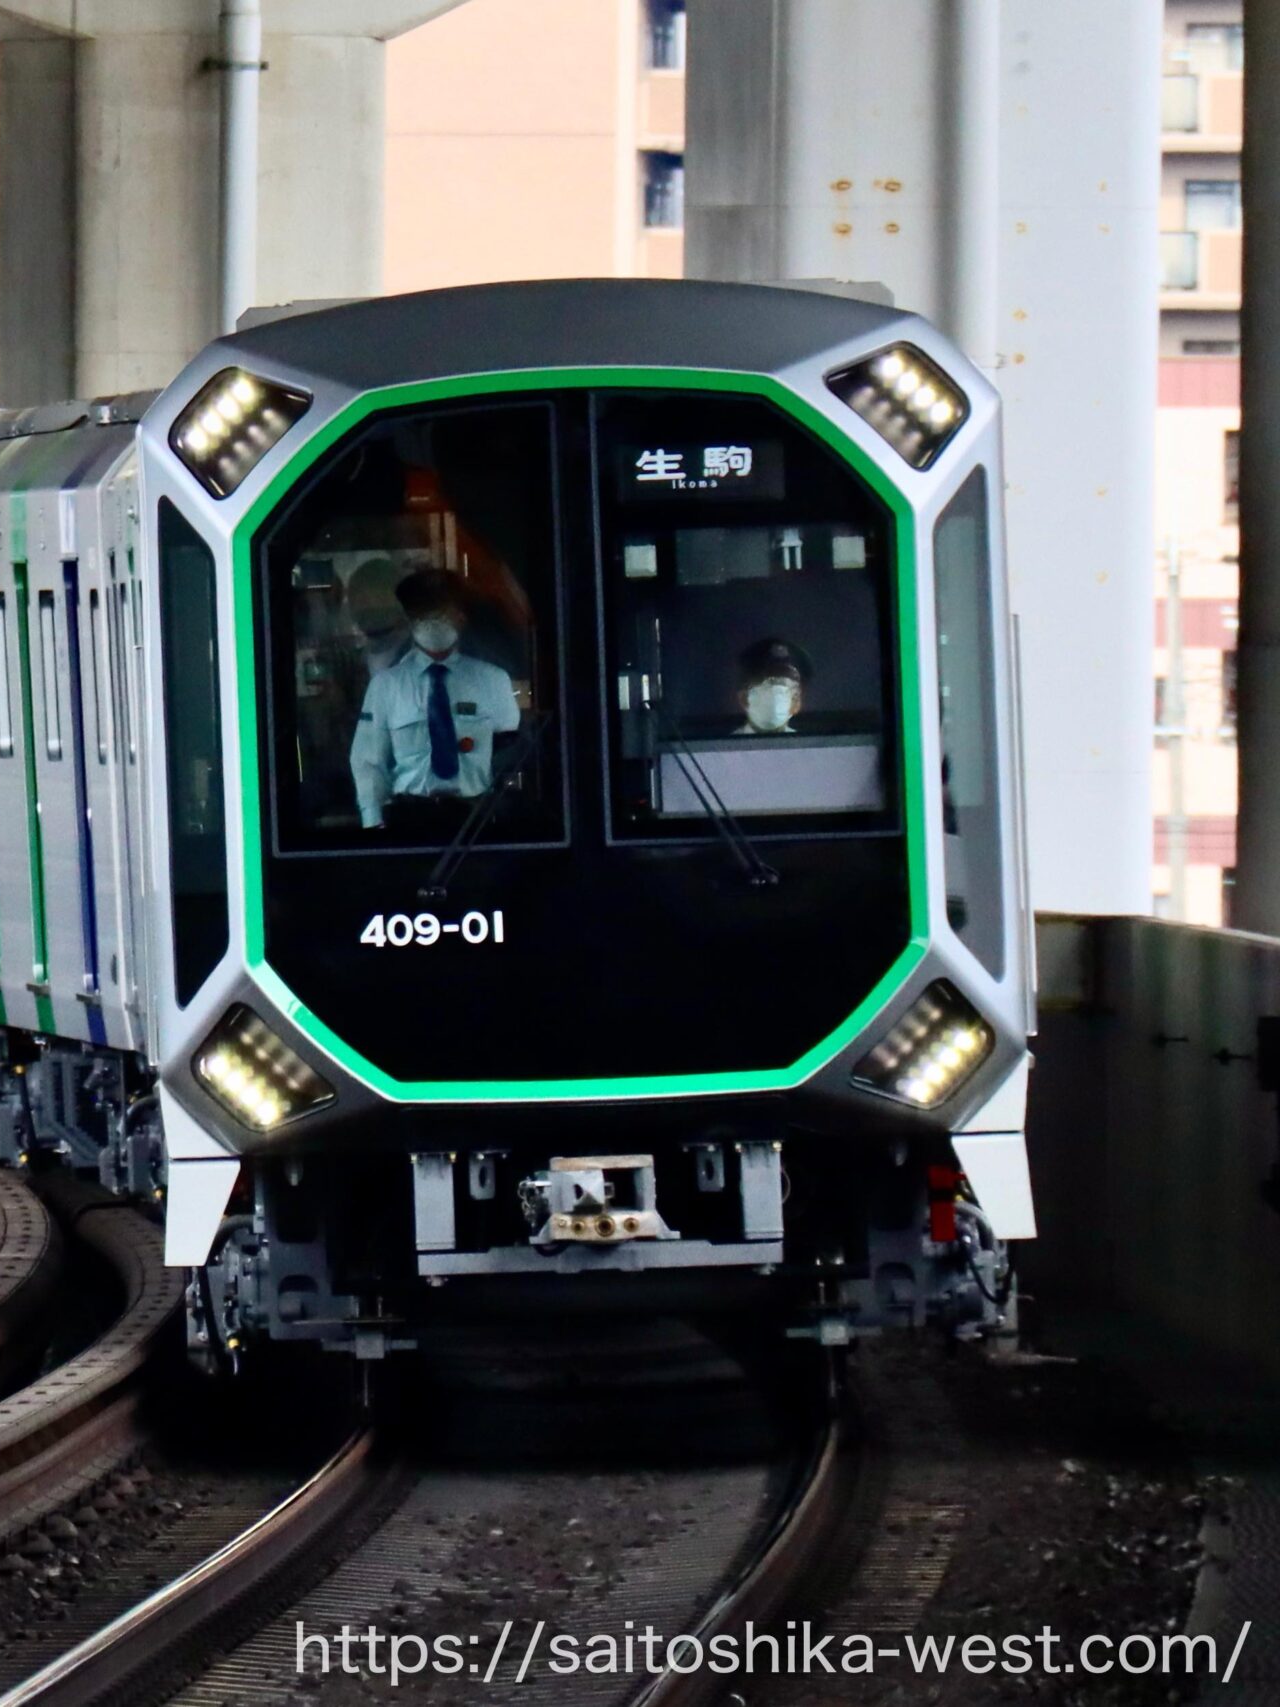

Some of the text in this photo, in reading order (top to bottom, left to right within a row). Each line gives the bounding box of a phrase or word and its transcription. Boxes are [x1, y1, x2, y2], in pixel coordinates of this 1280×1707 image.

[635, 445, 753, 481] 生駒
[671, 479, 718, 490] Ikoma
[359, 910, 504, 948] 409-01
